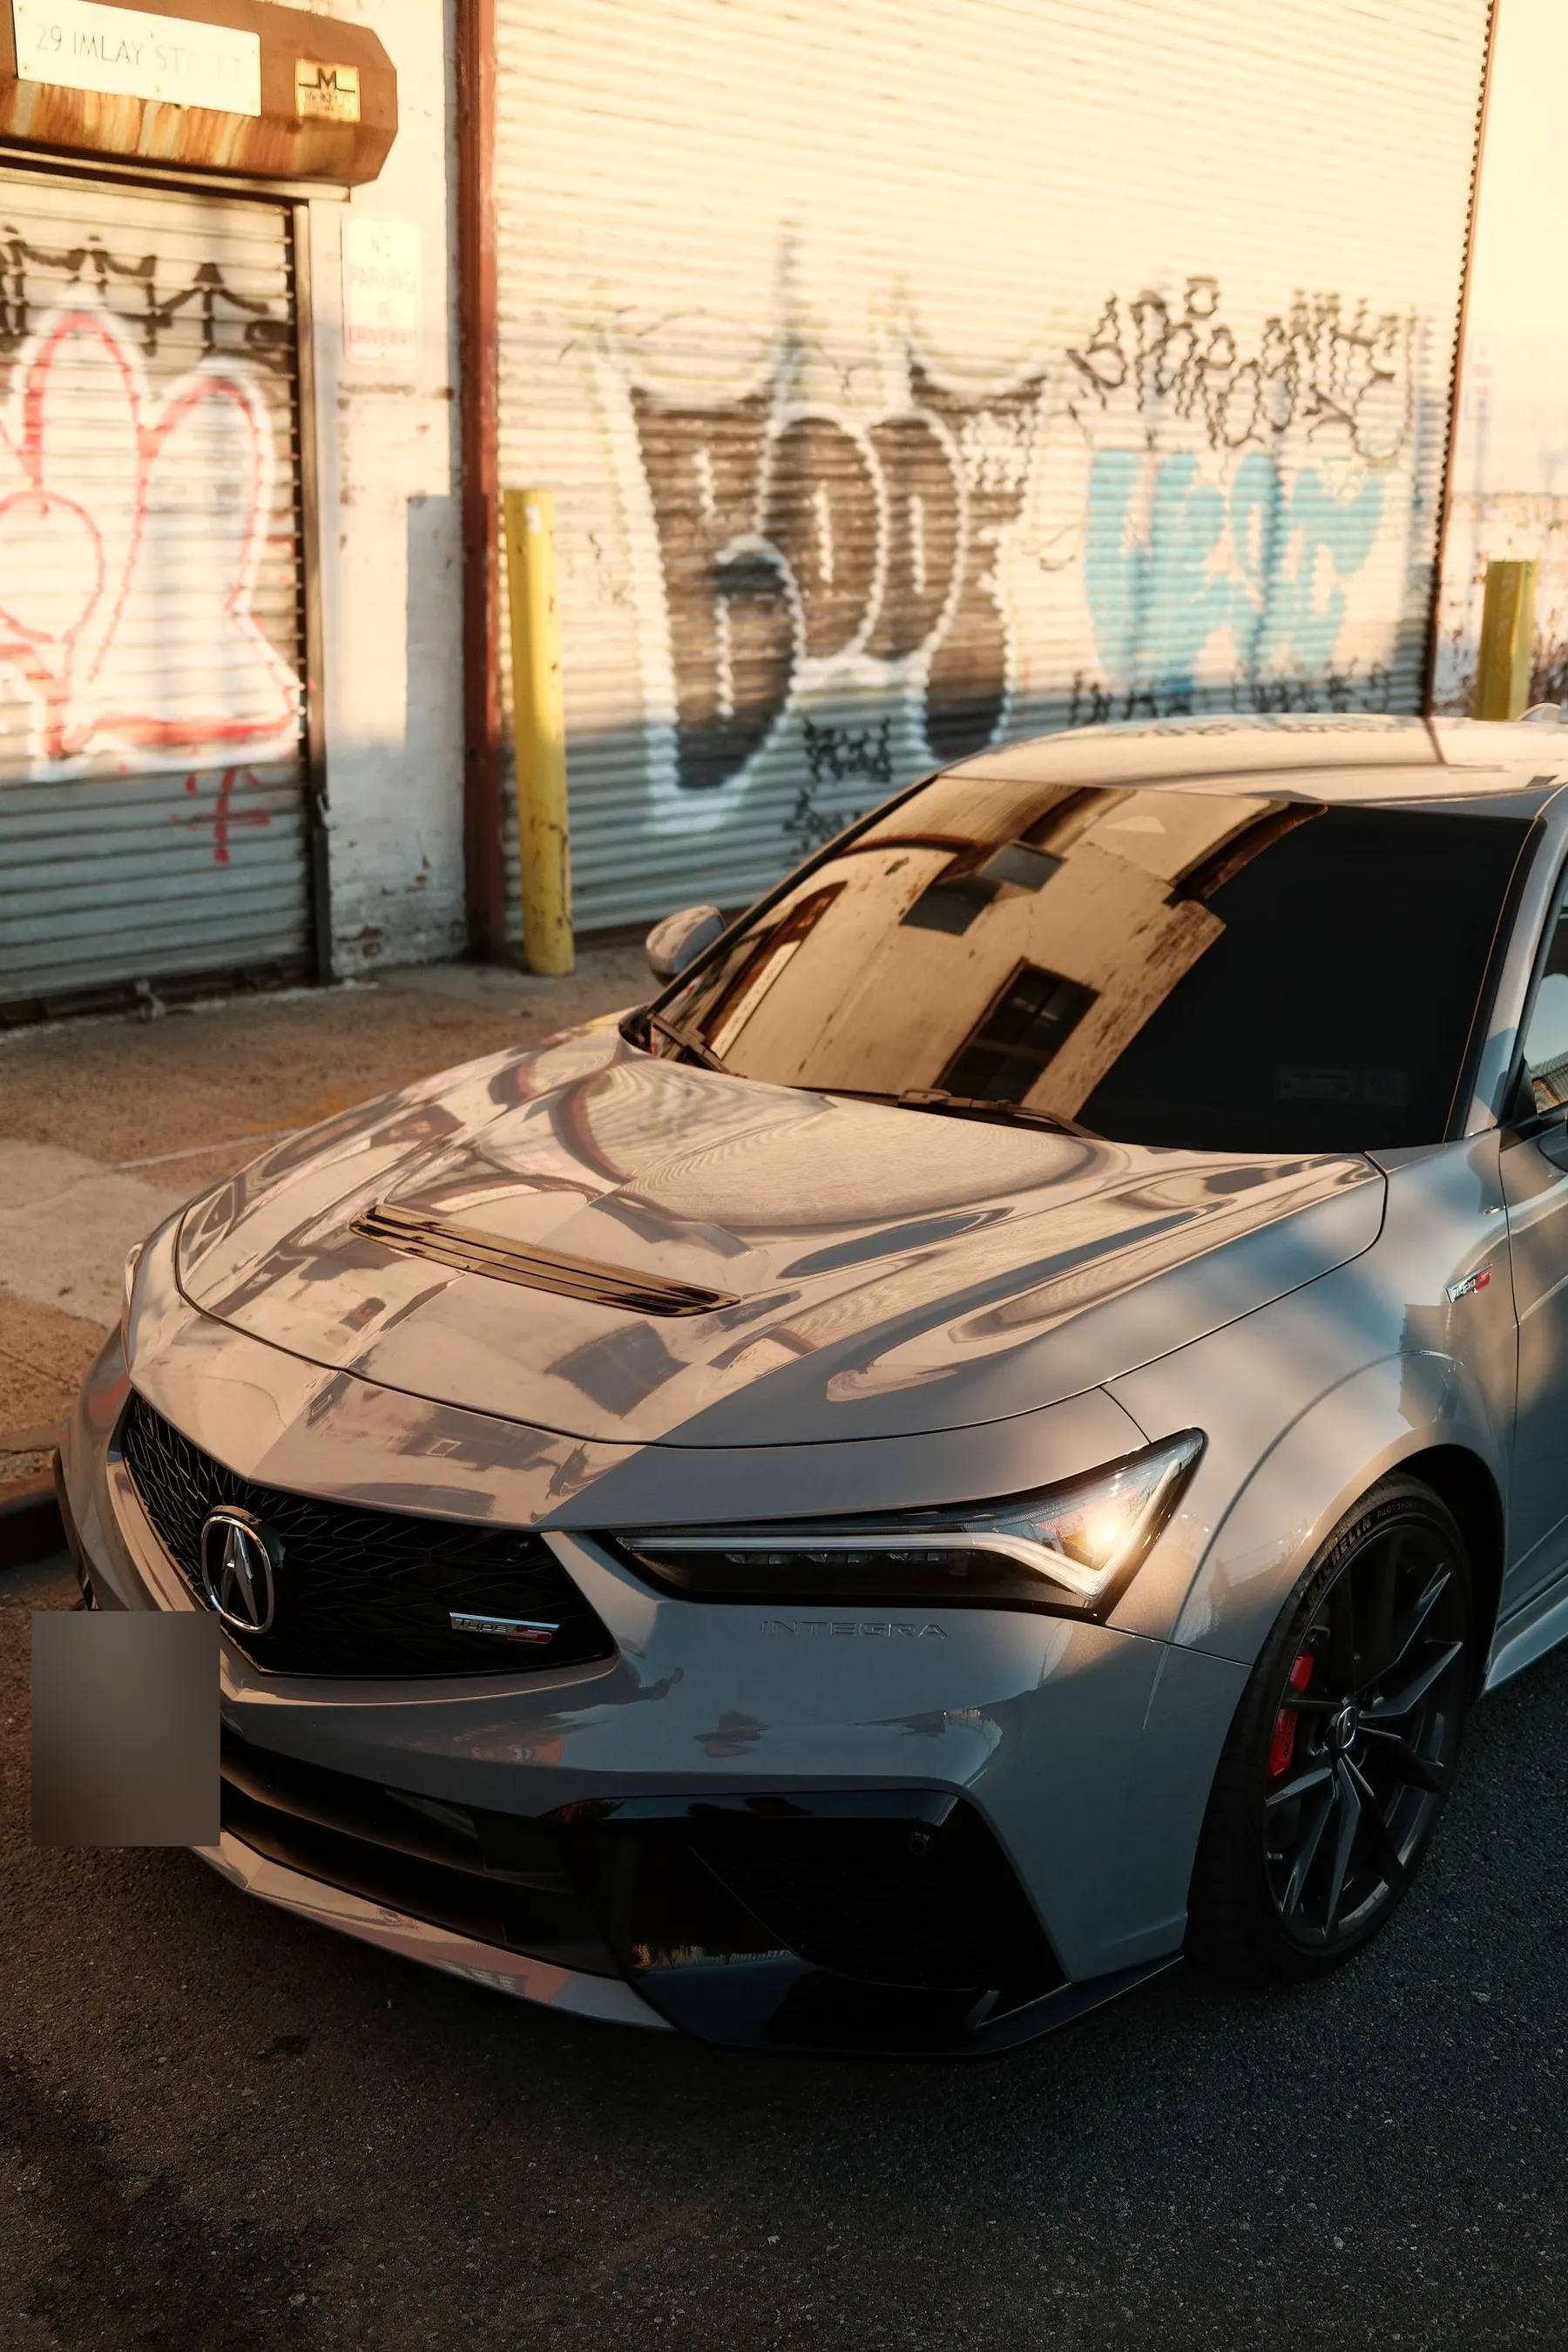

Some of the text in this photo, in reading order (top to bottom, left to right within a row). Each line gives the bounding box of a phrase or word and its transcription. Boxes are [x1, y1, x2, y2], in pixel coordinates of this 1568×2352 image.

[36, 22, 63, 52] 29
[72, 30, 145, 66] IMLAY
[1306, 1514, 1372, 1607] MICHELIN
[1377, 1504, 1395, 1519] PILOT
[760, 1619, 949, 1639] INTEGRA
